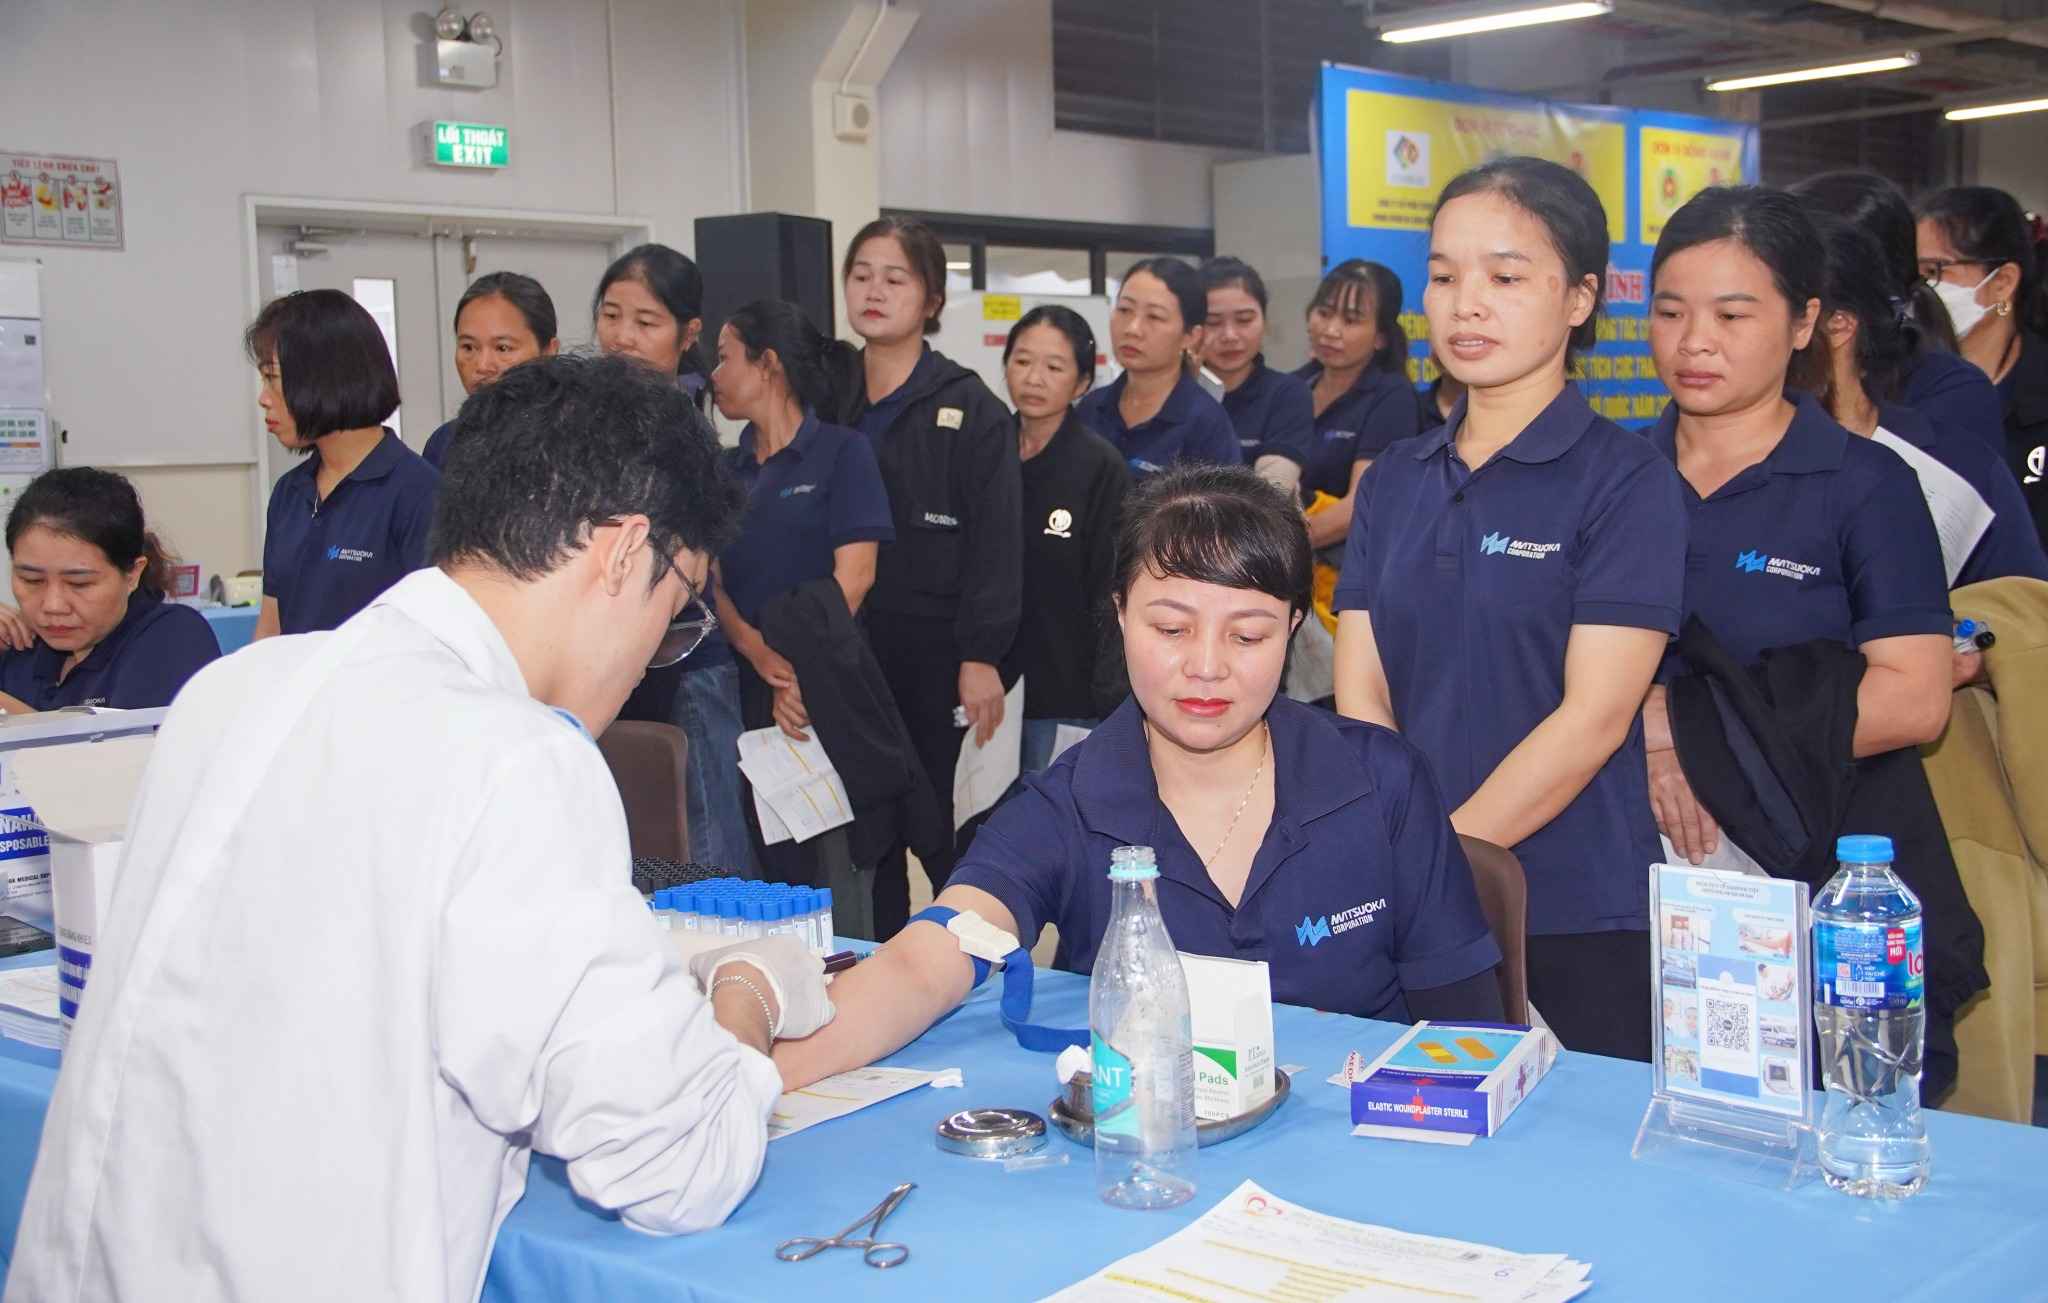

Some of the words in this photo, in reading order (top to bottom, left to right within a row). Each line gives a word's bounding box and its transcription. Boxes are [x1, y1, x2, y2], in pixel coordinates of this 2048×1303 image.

[438, 124, 460, 144] LỐI
[462, 126, 504, 147] THOÁT
[452, 143, 492, 165] EXIT
[1510, 540, 1561, 552] MATSUOKA
[1768, 557, 1821, 576] MATSUOKA
[0, 834, 49, 854] SPOSABLE
[1331, 898, 1387, 926] MATSUOKA
[1332, 914, 1374, 935] CORPORATION
[1199, 1071, 1229, 1086] Pads
[1368, 1101, 1393, 1113] ELASTIC
[1393, 1103, 1443, 1117] WOUNDPLASTER
[1443, 1108, 1469, 1119] STERILE
